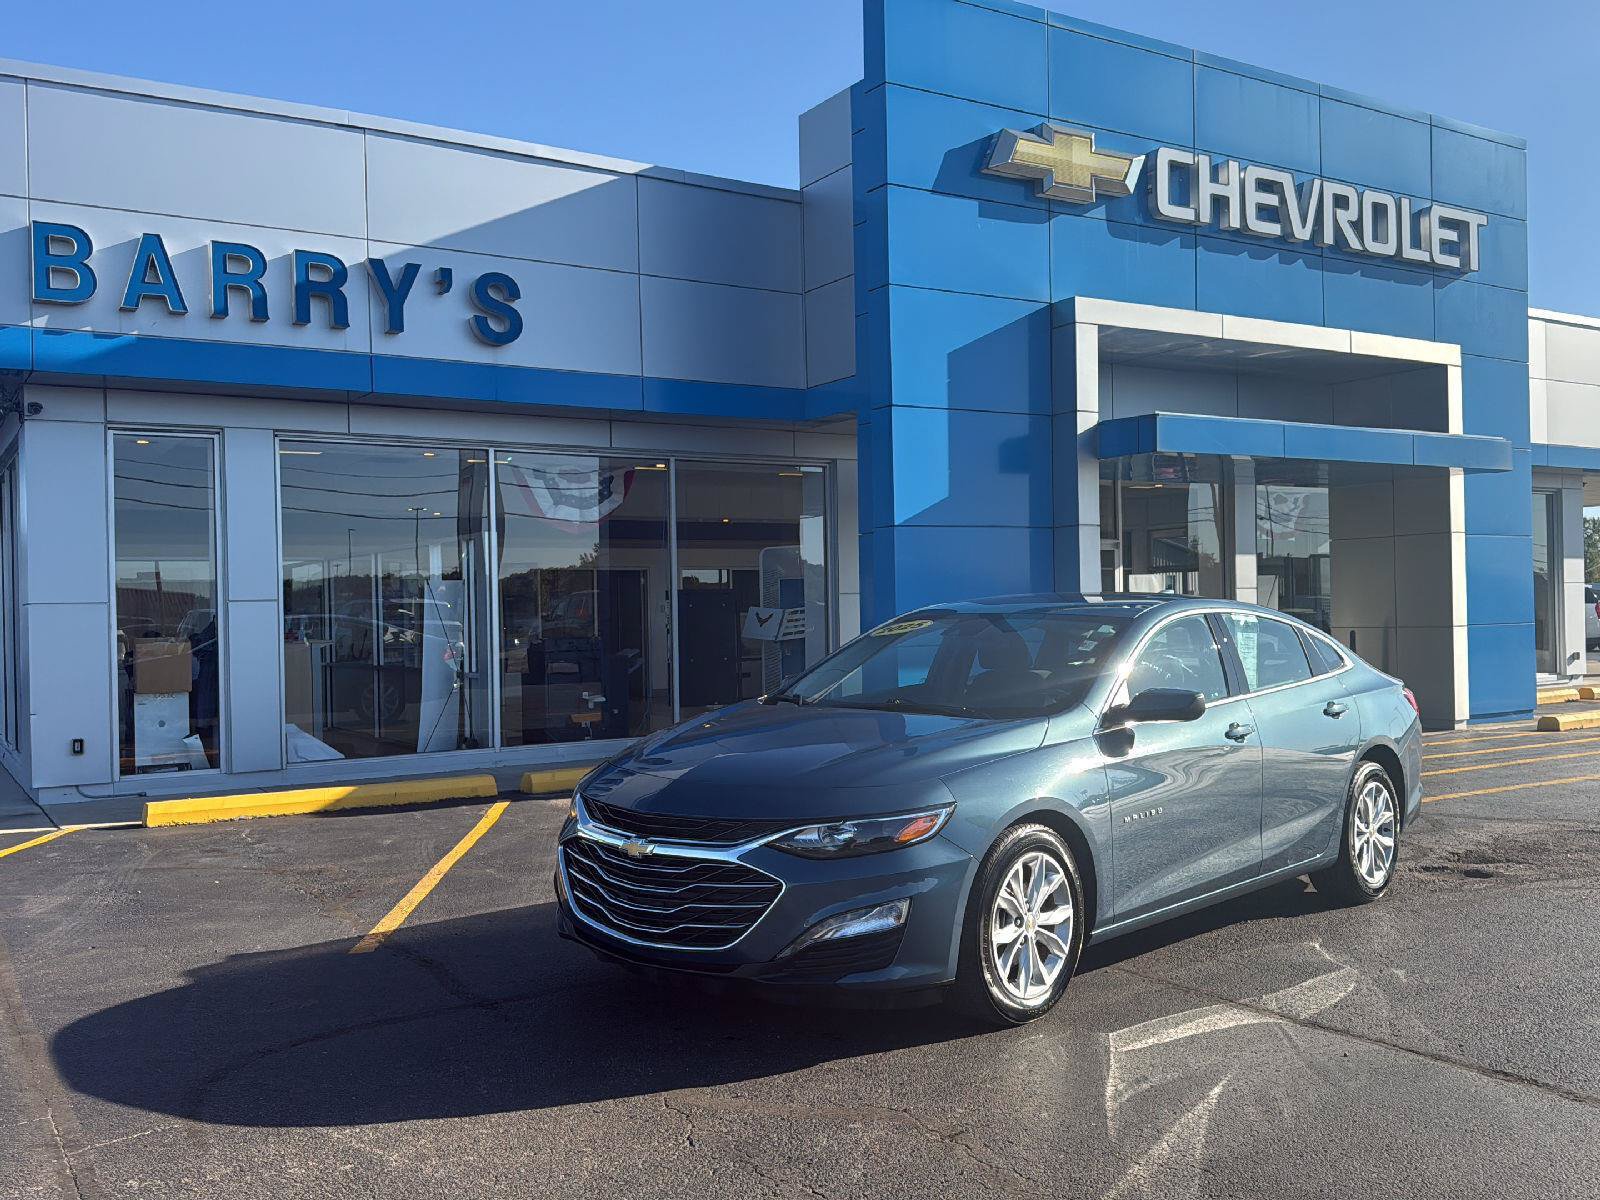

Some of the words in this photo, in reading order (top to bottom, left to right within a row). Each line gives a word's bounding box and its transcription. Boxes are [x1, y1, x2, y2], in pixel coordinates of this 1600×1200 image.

[1153, 146, 1488, 272] CHEVROLET
[31, 220, 525, 347] BARRY'S
[1123, 807, 1163, 823] MALIBU
